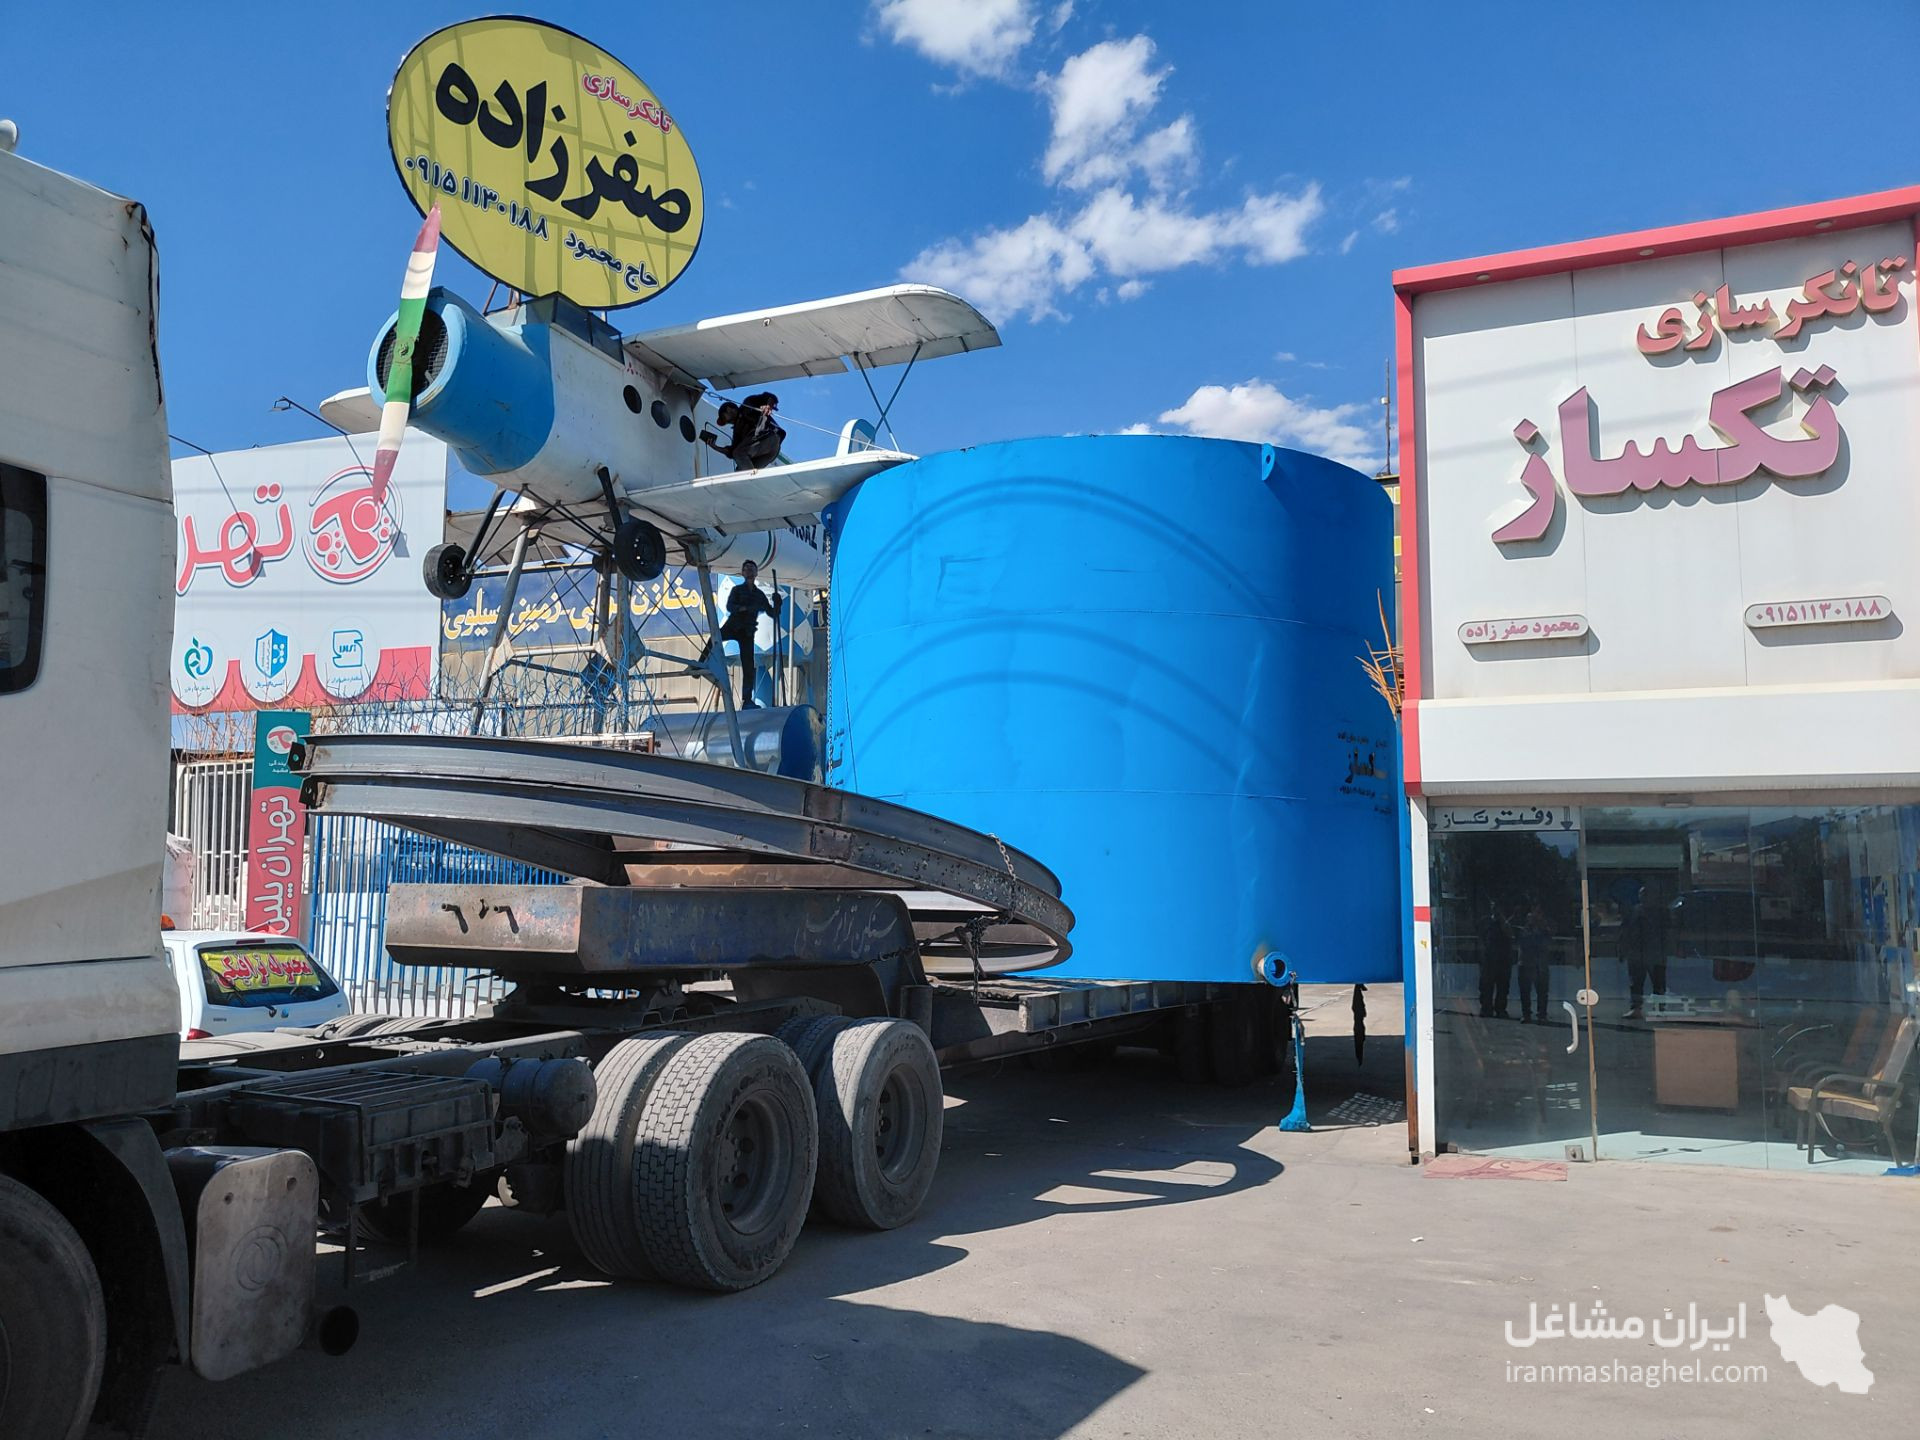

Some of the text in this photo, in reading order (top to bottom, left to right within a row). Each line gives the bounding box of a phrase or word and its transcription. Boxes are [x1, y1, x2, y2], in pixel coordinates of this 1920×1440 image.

[405, 157, 549, 239] ۰۹۱۵۱۱۳۰۱۸۸
[566, 231, 658, 290] حاج محمود
[1492, 364, 1840, 542] تکساز
[176, 482, 294, 594] تهر
[1532, 621, 1580, 637] محمود
[1756, 600, 1882, 624] ۰۹۱۵۱۱۳۰۱۸۸
[256, 795, 297, 876] تهران
[1443, 806, 1553, 829] دفتر تکساز
